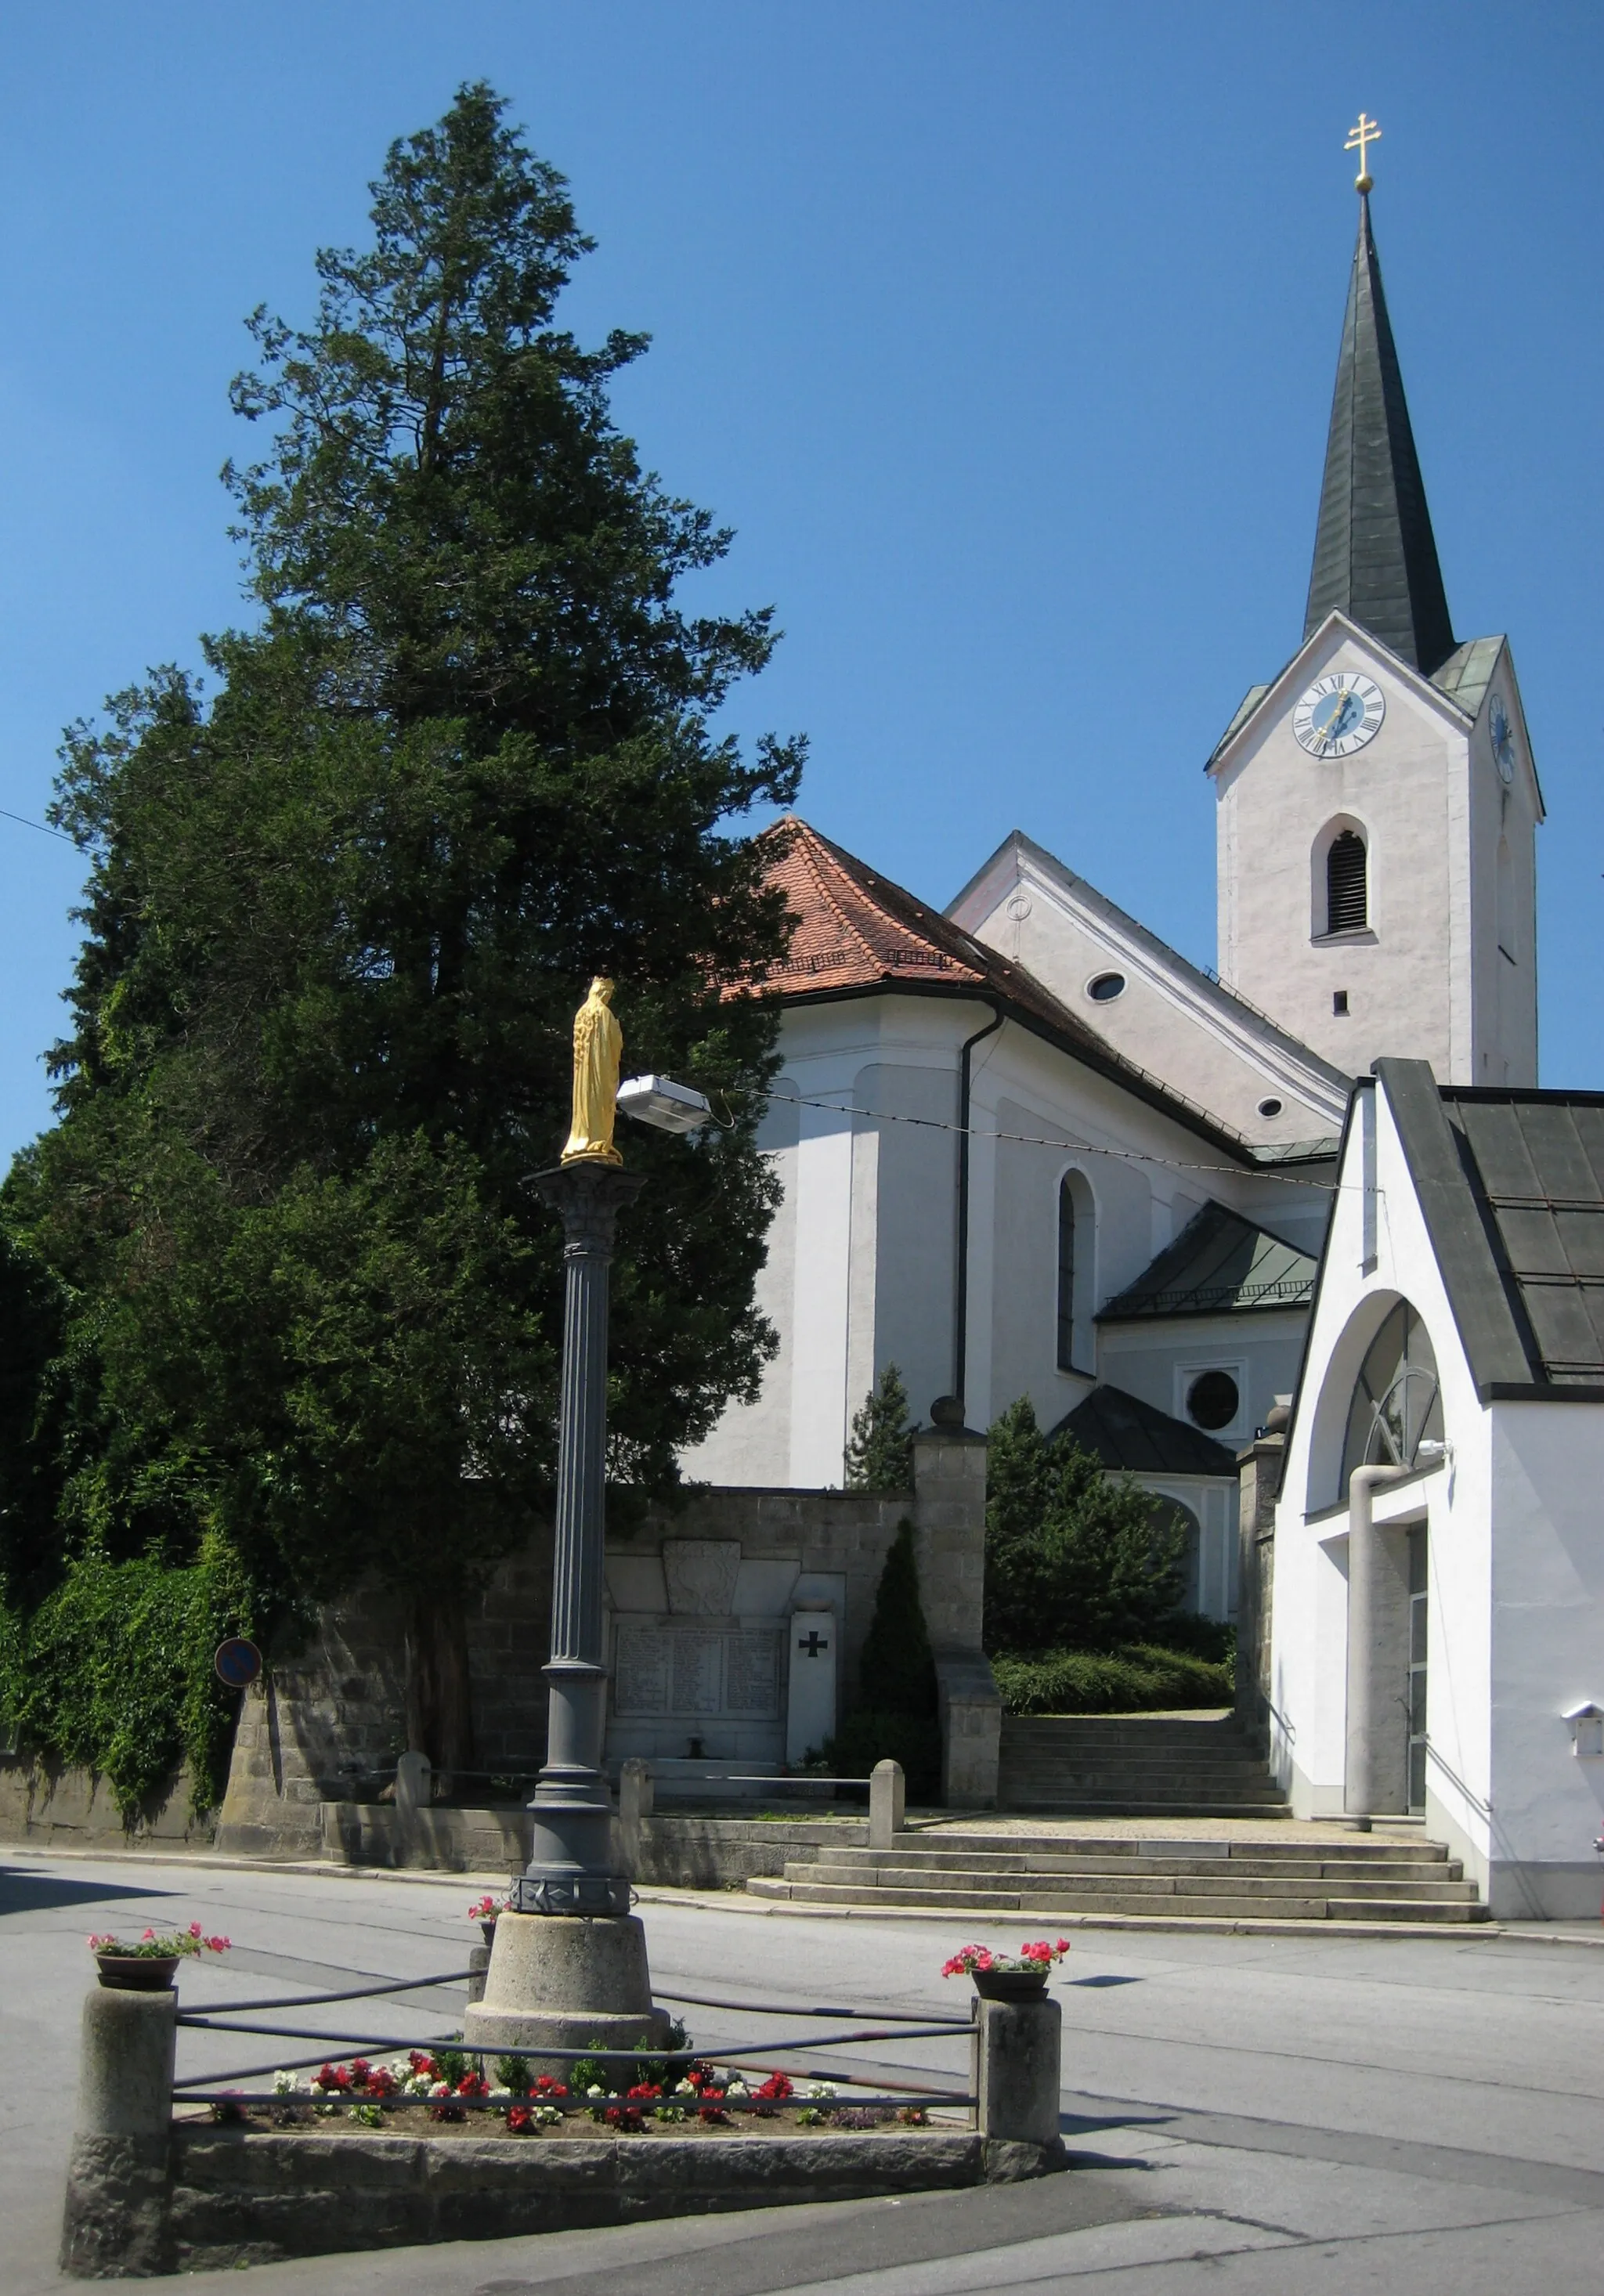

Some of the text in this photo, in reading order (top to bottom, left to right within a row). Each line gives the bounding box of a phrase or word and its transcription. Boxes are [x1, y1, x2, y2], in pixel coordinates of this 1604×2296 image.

[1330, 674, 1344, 690] XII
[1351, 676, 1360, 690] I
[1311, 683, 1328, 699] XI
[1361, 685, 1377, 699] II
[1299, 699, 1315, 709] X
[1365, 701, 1382, 713] III
[1353, 734, 1365, 746] V
